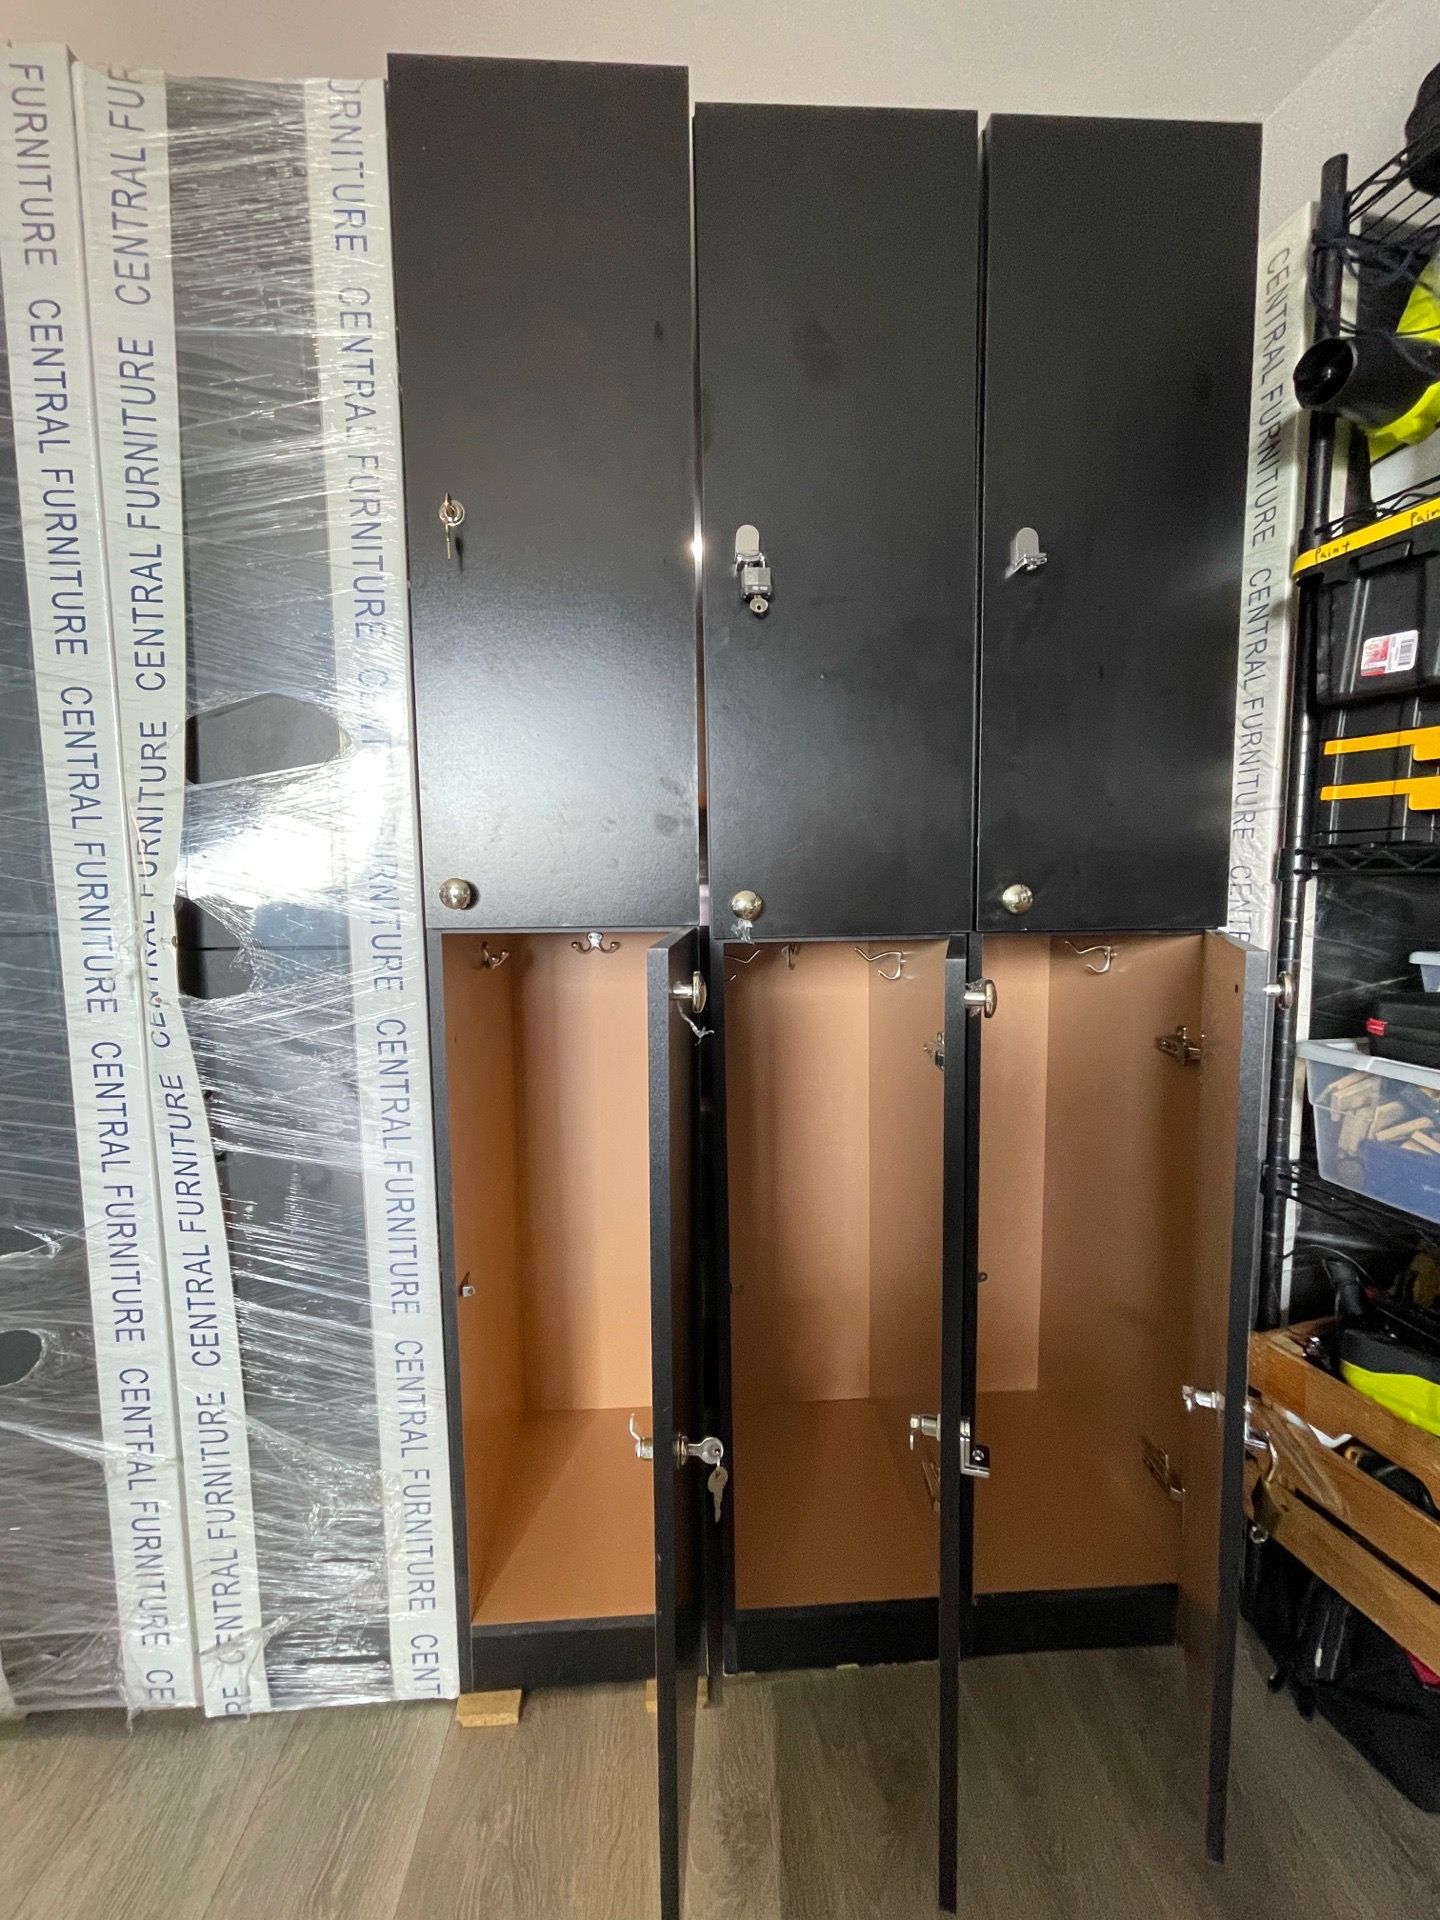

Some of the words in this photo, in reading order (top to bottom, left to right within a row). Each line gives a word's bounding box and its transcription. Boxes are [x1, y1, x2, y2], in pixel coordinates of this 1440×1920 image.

[8, 63, 57, 267] FURNITURE
[110, 147, 152, 305] CENTRAL
[28, 299, 71, 455] CENTRAL
[1260, 247, 1290, 385] CENTRAL
[118, 337, 160, 529] FURNITURE
[1252, 384, 1283, 548] FURNITURE
[41, 468, 89, 656] FURNITURE
[129, 543, 167, 692] CENTRAL
[347, 454, 387, 638] FURNITURE
[1242, 568, 1272, 691] CENTRAL
[60, 686, 103, 830] CENTRAL
[136, 720, 168, 897] FURNITURE
[1233, 696, 1265, 841] FURNITURE
[74, 842, 118, 1014] FURNITURE
[91, 1041, 132, 1173] CENTRAL
[159, 1073, 206, 1233] FURNITURE
[376, 1018, 412, 1150] CENTRAL
[103, 1185, 145, 1343] FURNITURE
[182, 1244, 221, 1367] CENTRAL
[384, 1160, 420, 1315] FURNITURE
[196, 1391, 236, 1541] FURNITURE
[394, 1339, 429, 1458] CENTRAL
[130, 1501, 170, 1647] FURNITURE
[403, 1470, 436, 1611] FURNITURE
